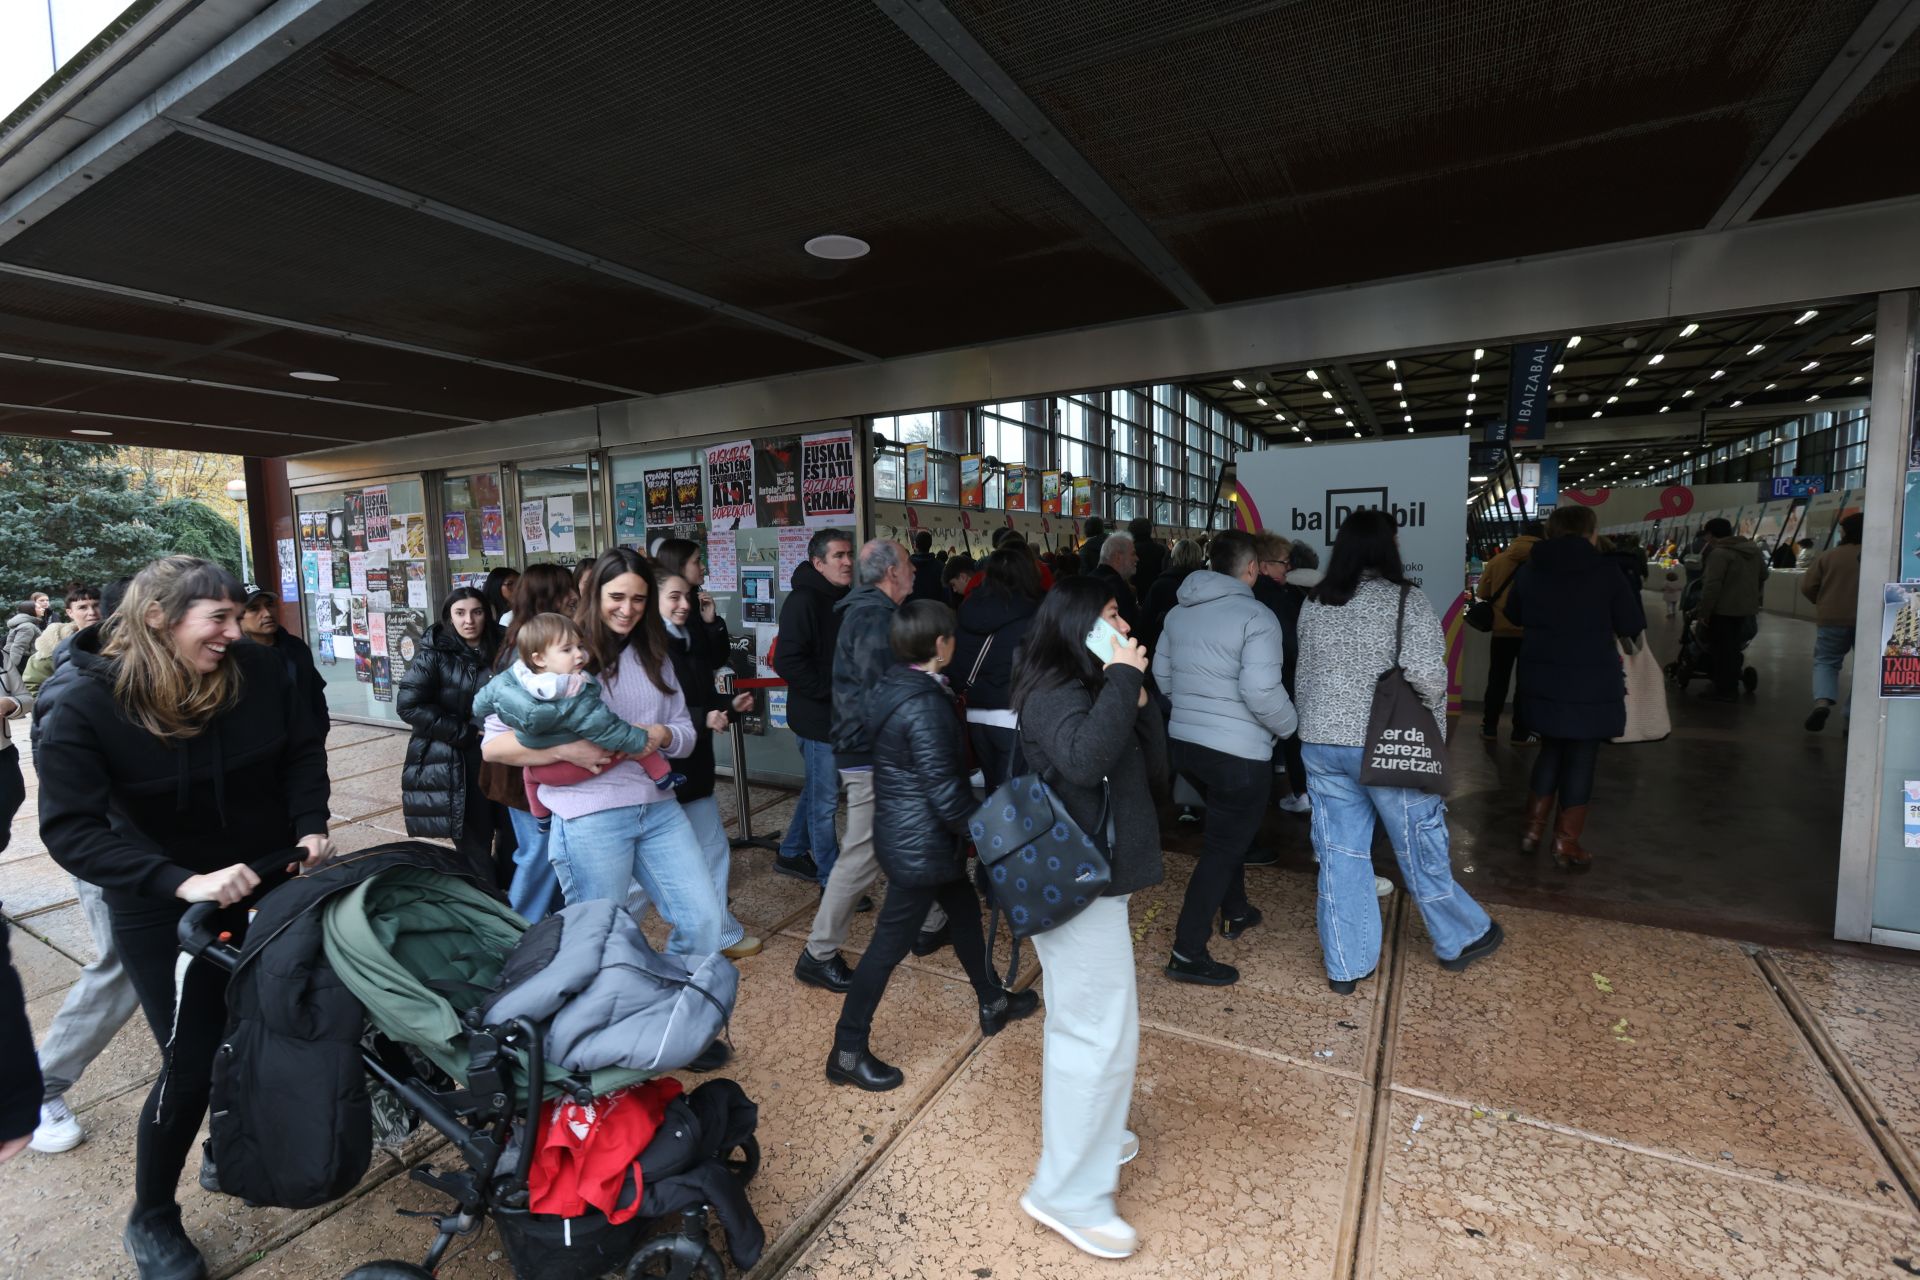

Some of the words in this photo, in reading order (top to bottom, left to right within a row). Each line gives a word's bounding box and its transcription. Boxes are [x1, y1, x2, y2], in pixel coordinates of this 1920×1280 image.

[1517, 345, 1548, 422] IBAIZABAL
[804, 442, 853, 463] EUSKAL
[804, 461, 853, 480] ESTATU
[803, 476, 855, 492] SOZIALISTA
[1774, 478, 1790, 496] 02
[1380, 728, 1402, 740] er
[1404, 728, 1424, 742] da
